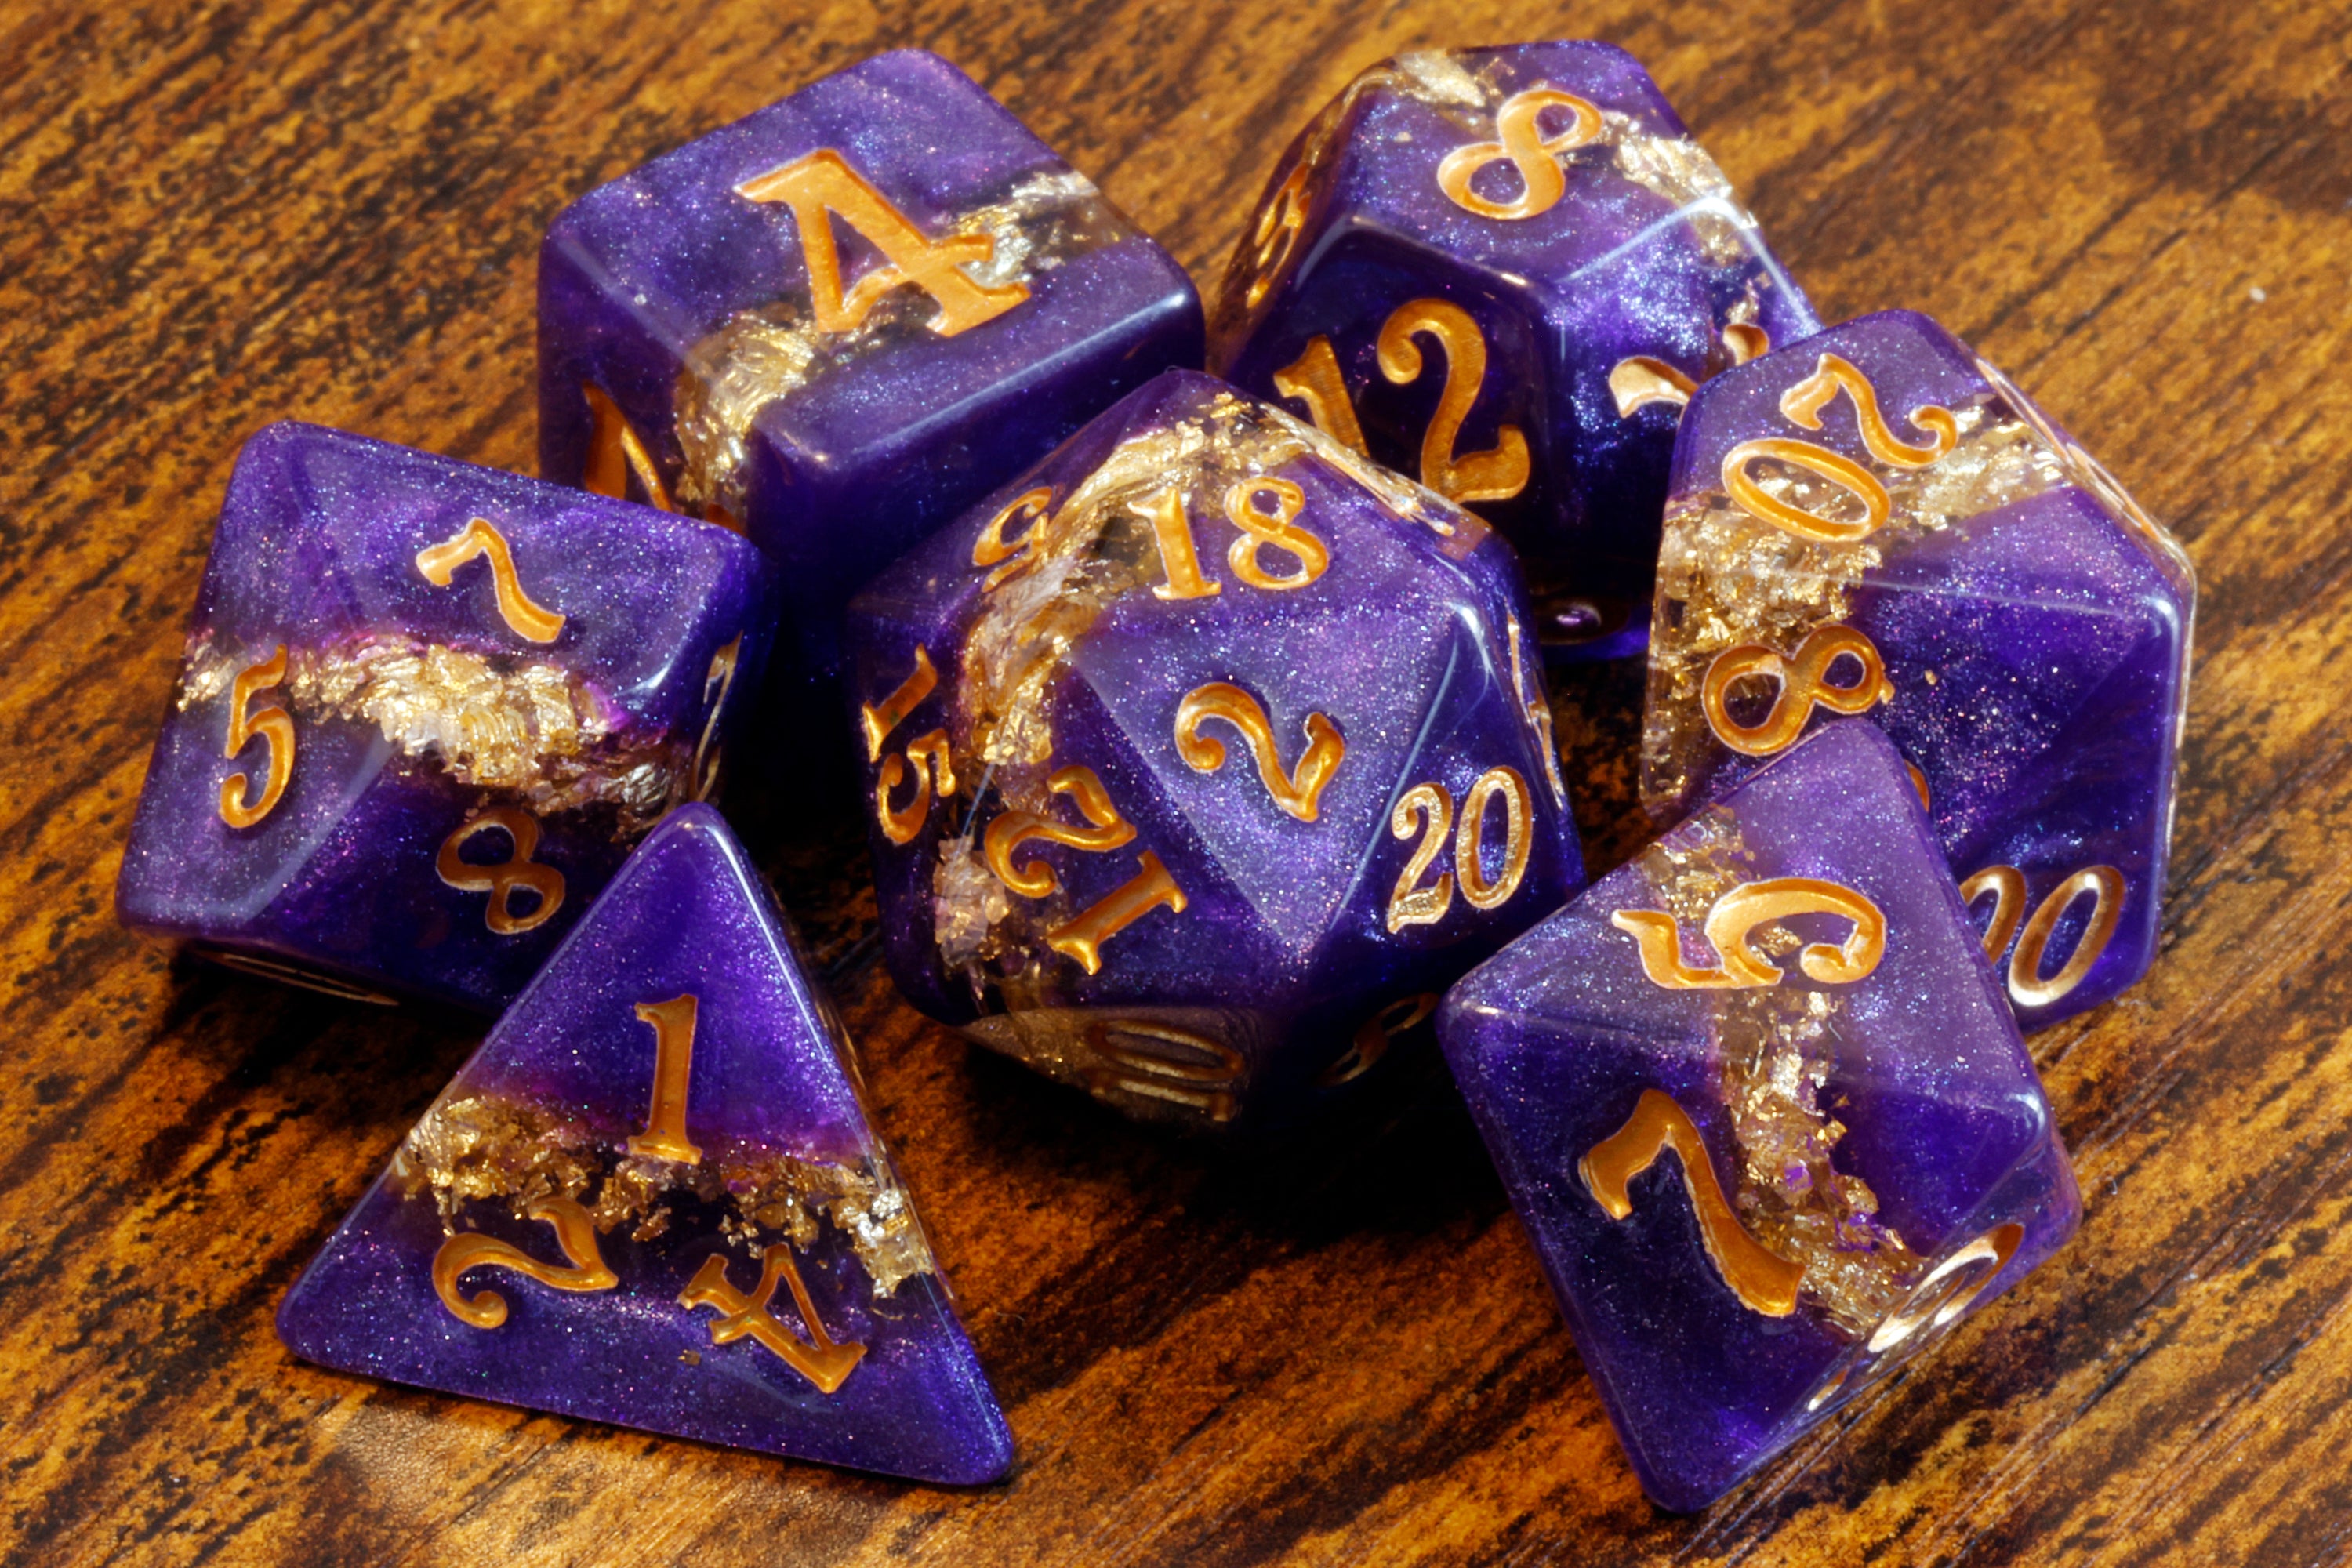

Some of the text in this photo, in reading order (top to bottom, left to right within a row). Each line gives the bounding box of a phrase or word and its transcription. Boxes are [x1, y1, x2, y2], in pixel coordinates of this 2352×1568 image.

[1439, 89, 1604, 220] 8
[734, 147, 1032, 338] 4
[1273, 298, 1531, 504] 12
[1722, 352, 1959, 543] 20
[416, 516, 567, 644] 7
[1127, 477, 1330, 601] 18
[220, 644, 296, 829] 5
[862, 643, 956, 844] 15
[1174, 681, 1345, 823] 2
[435, 808, 566, 936] 8
[985, 763, 1189, 975] 12
[1387, 764, 1534, 935] 20
[1611, 877, 1887, 990] 5
[629, 993, 702, 1166] 1
[432, 1196, 619, 1330] 2
[1577, 1088, 1806, 1317] 7
[677, 1242, 868, 1394] 4
